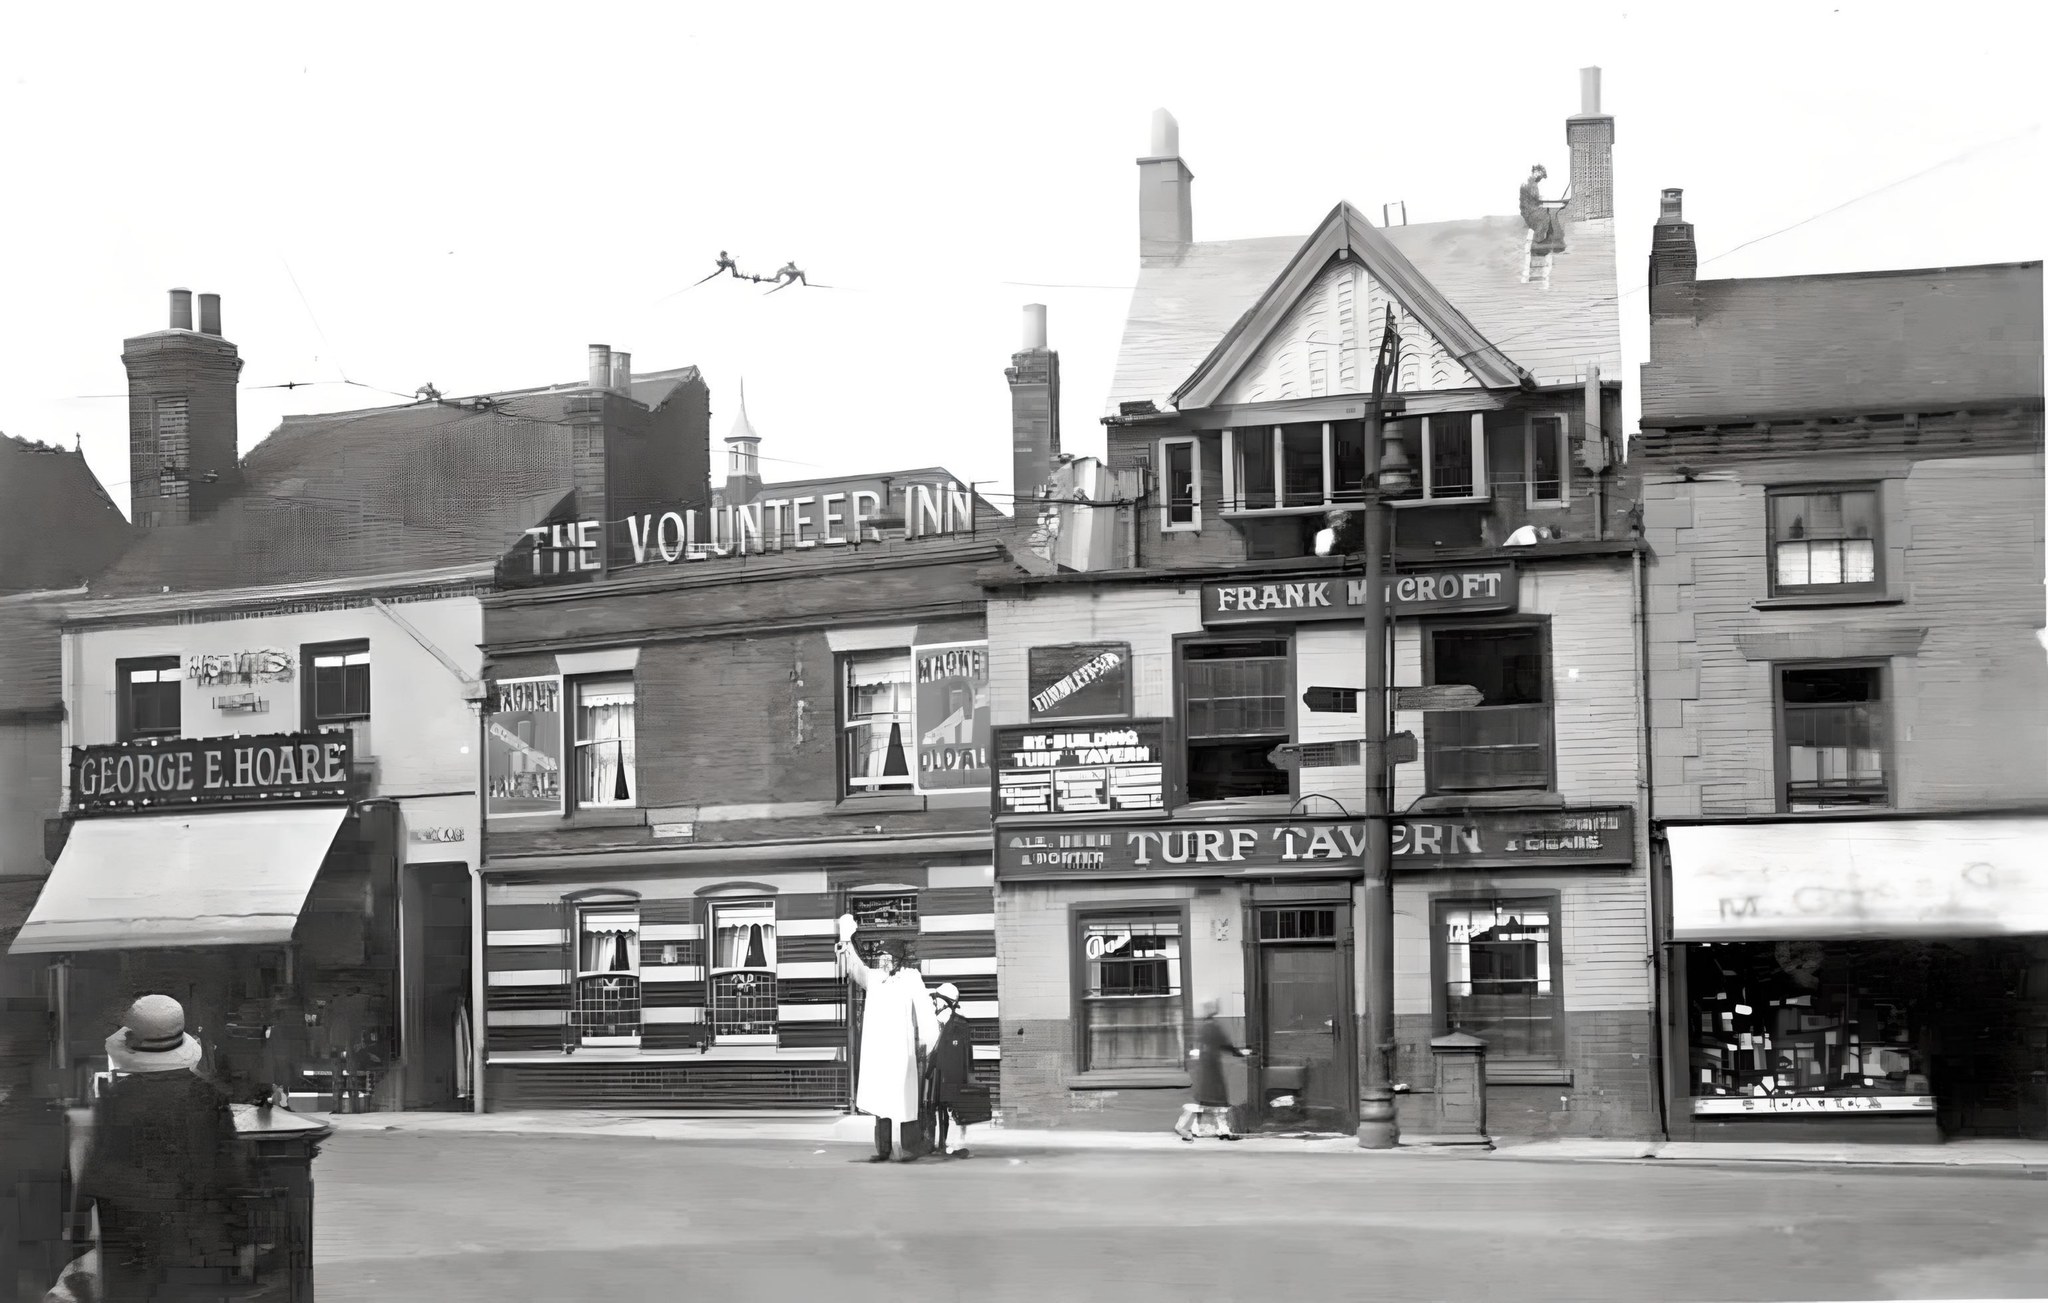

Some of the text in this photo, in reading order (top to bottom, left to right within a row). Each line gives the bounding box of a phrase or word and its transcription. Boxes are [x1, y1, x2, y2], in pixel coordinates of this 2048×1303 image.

[525, 480, 973, 576] THE VOLUNTEER INN
[1217, 581, 1332, 612] FRANK
[80, 751, 194, 796] GEORGE
[232, 743, 346, 788] HOARE
[1126, 828, 1258, 865] TURF
